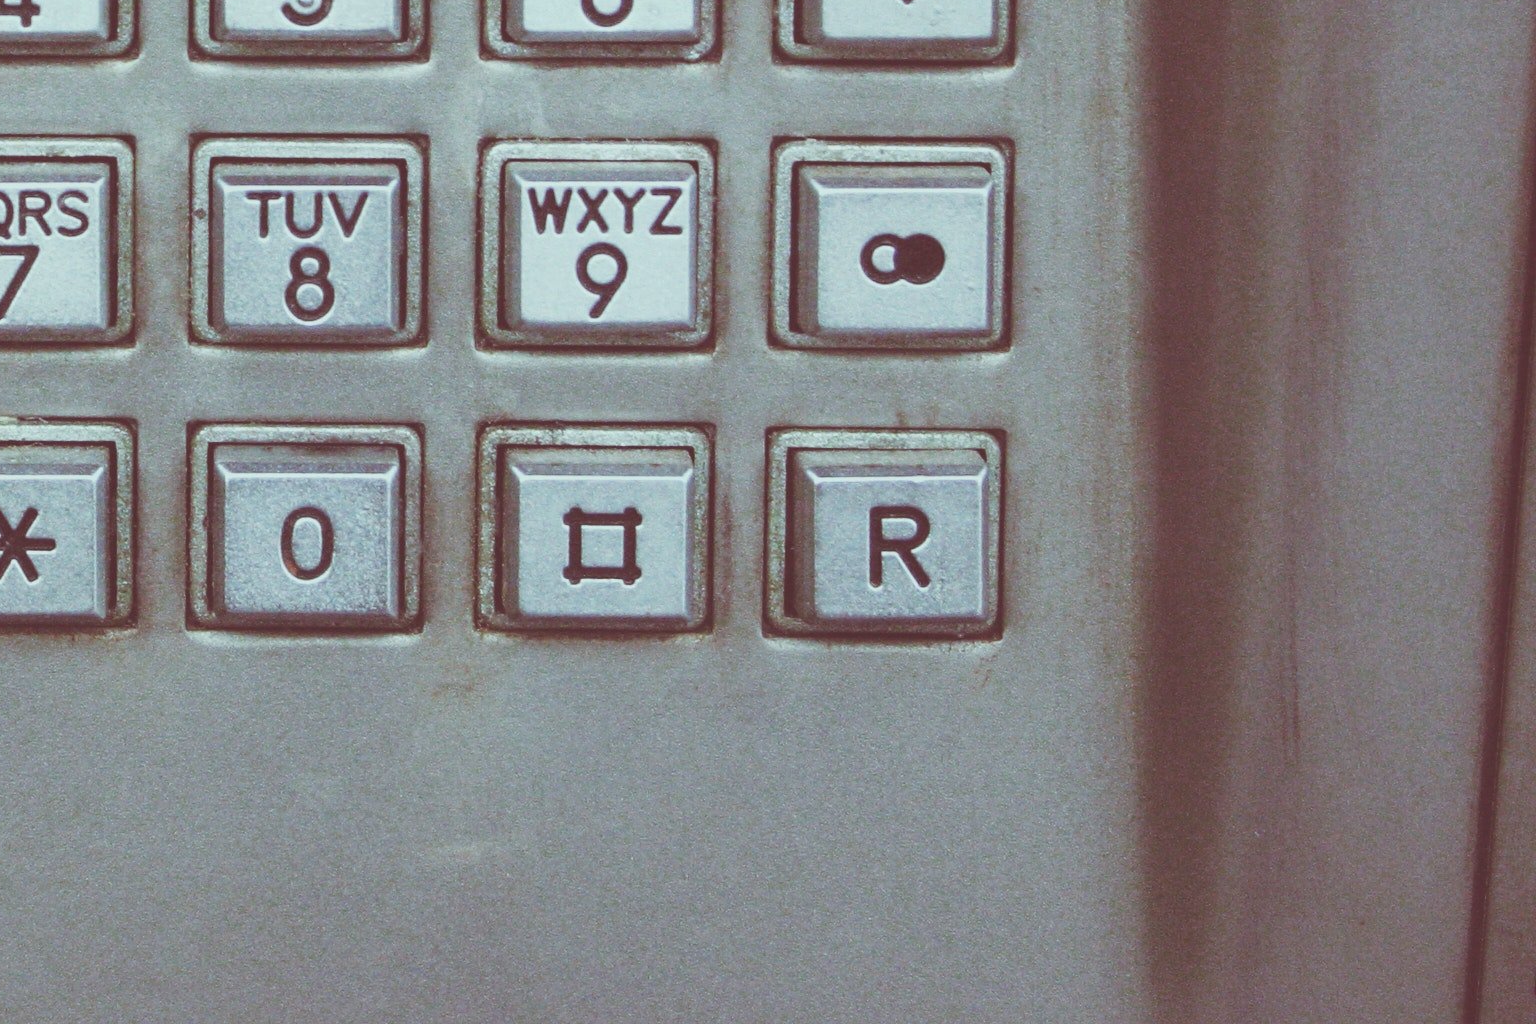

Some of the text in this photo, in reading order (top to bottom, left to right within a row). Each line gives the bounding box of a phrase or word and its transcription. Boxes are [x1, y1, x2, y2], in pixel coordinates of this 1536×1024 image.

[246, 190, 370, 237] TUV
[526, 186, 684, 235] WXYZ
[284, 245, 335, 322] 8
[574, 242, 629, 320] 9
[870, 504, 931, 587] R
